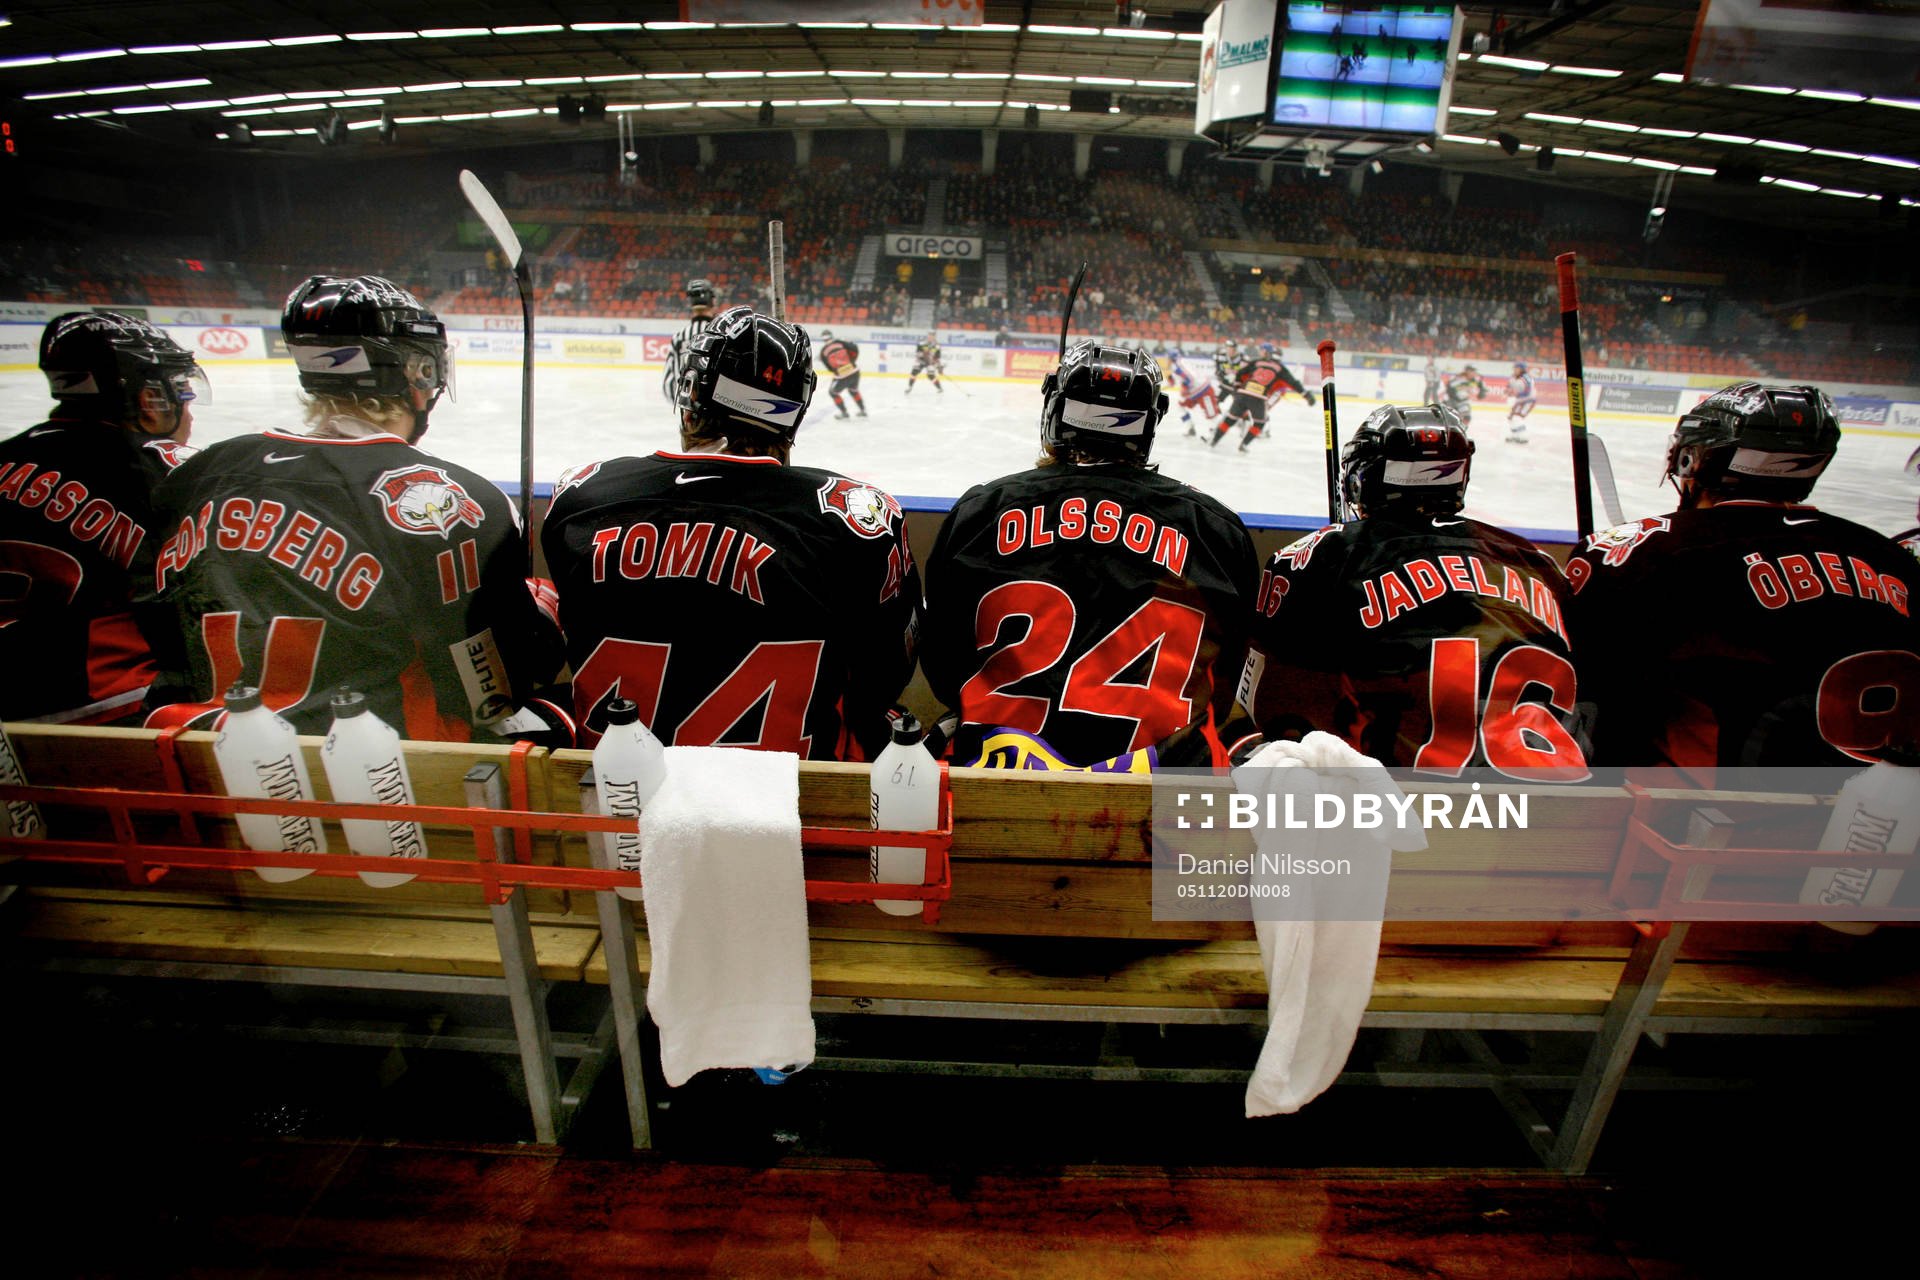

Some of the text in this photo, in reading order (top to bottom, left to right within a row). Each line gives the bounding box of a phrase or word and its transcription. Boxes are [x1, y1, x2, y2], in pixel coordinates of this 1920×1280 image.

[896, 236, 972, 257] areco
[202, 331, 243, 347] AXA
[762, 364, 784, 387] 44
[1102, 367, 1122, 382] 24
[713, 391, 762, 416] prominent
[1063, 414, 1106, 430] prominent
[1791, 411, 1803, 426] 9
[157, 498, 383, 611] FORSBERG
[997, 497, 1188, 576] OLSSON
[437, 538, 480, 605] 11
[592, 522, 776, 605] TOMIK
[1743, 552, 1910, 618] ÖBERG
[1256, 569, 1290, 618] 16
[466, 642, 497, 694] FLITE
[960, 580, 1206, 754] 24
[1241, 656, 1256, 704] FLITE
[572, 637, 826, 762] 44
[1412, 637, 1593, 784] 16
